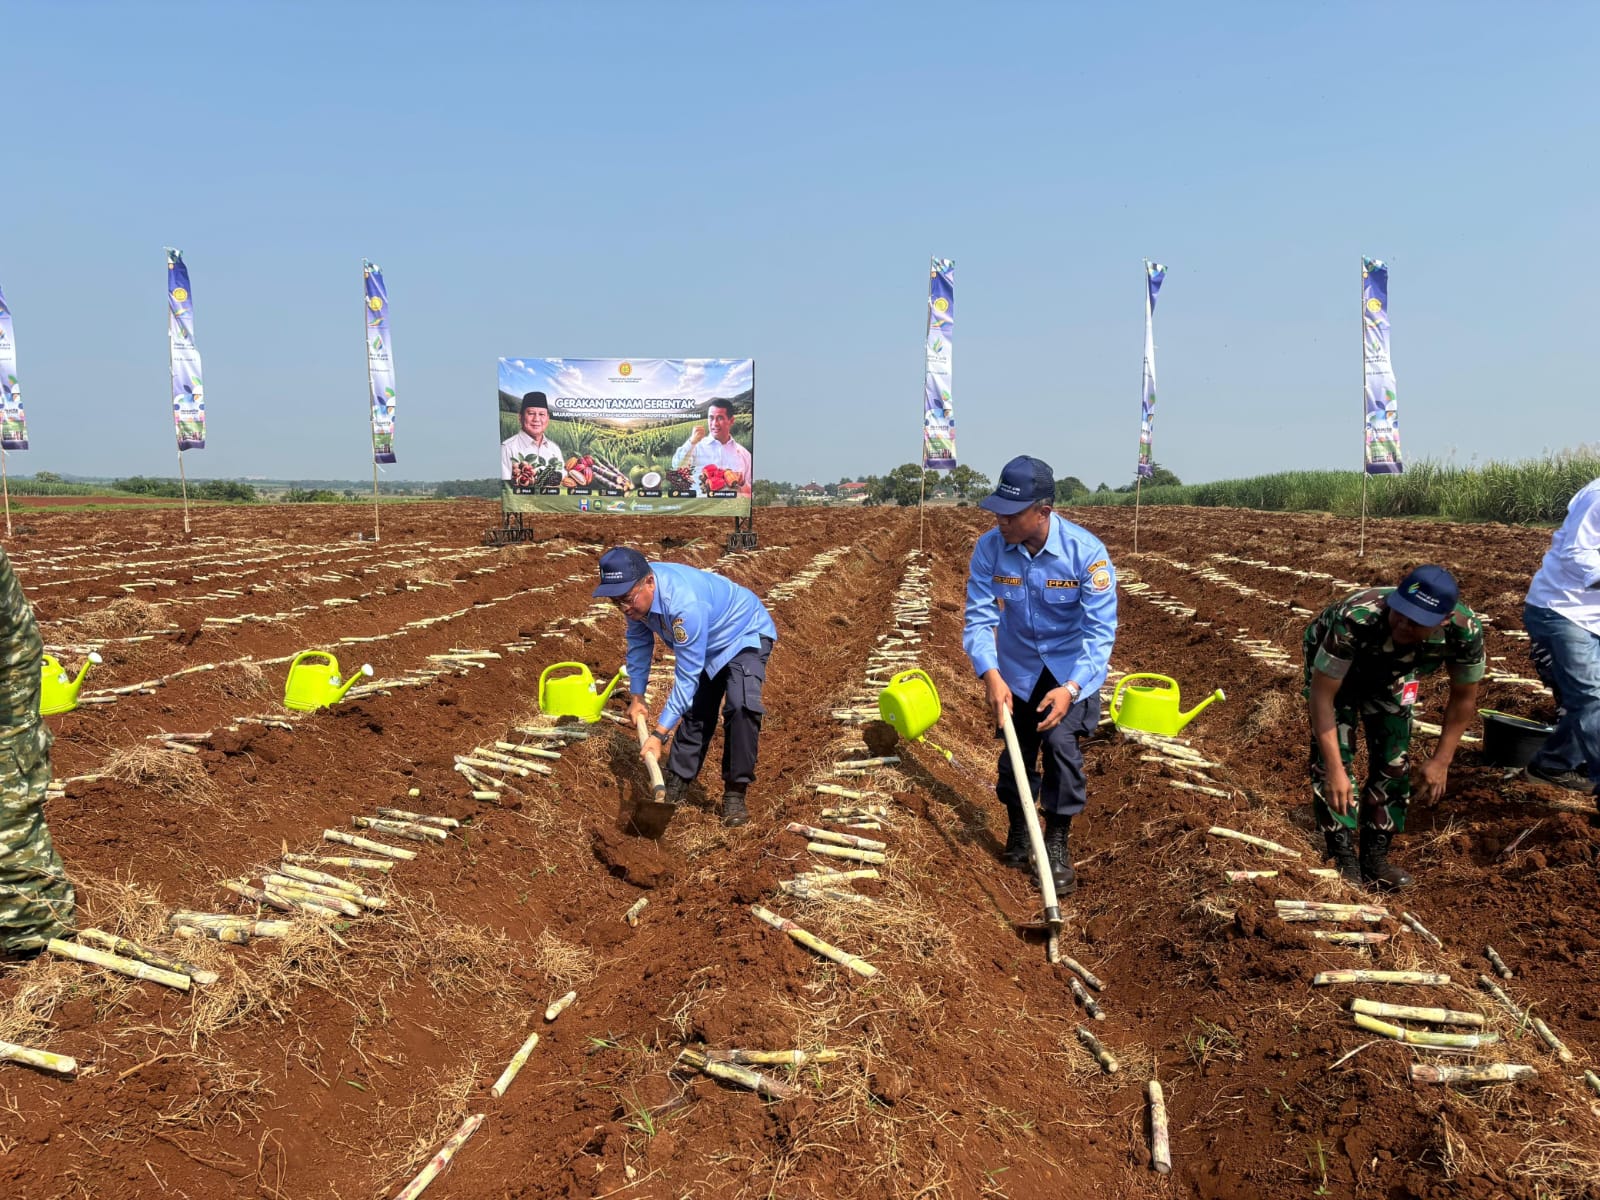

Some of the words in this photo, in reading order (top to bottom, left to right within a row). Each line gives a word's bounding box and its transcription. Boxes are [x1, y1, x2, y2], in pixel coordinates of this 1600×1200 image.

[555, 398, 604, 408] GERAKAN
[606, 398, 642, 409] TANAM
[645, 399, 695, 409] SERENTAK
